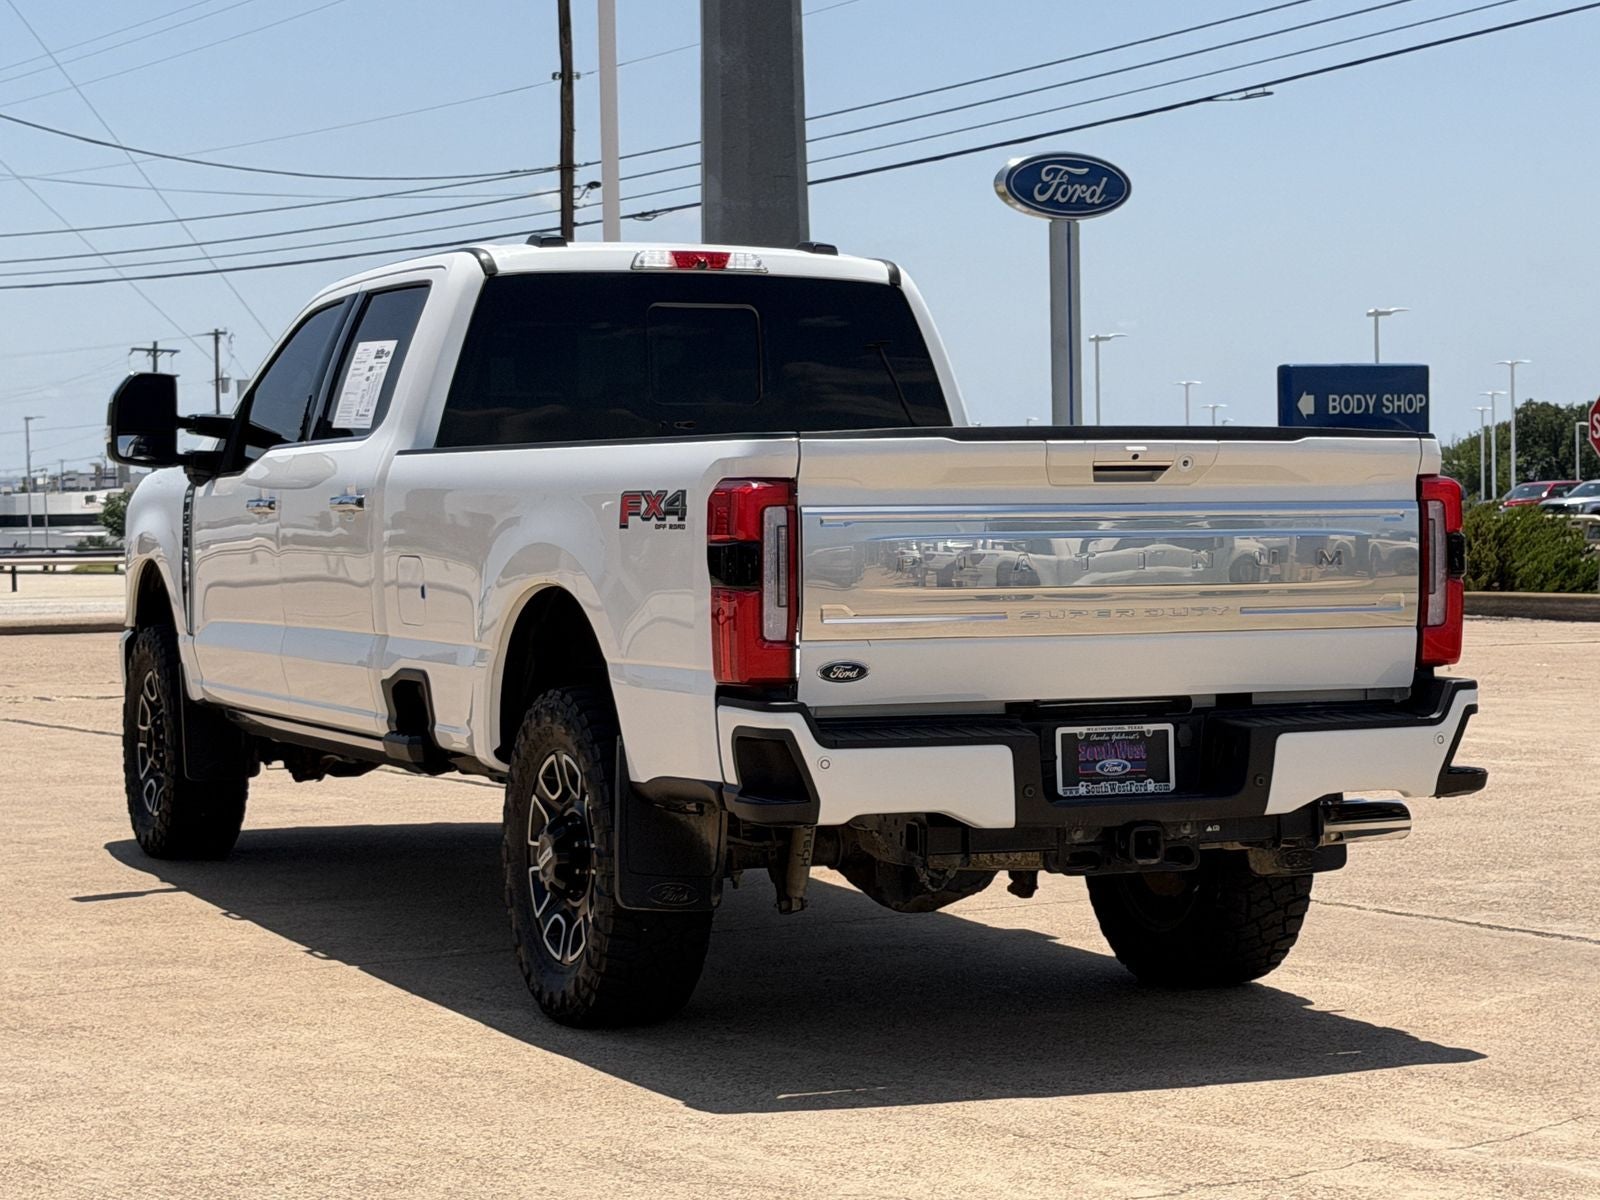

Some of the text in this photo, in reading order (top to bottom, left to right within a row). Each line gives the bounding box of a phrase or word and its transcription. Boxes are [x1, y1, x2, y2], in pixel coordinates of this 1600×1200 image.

[1033, 164, 1107, 204] Ford
[1328, 394, 1426, 414] BODY SHOP
[619, 489, 687, 529] FX4
[1019, 606, 1230, 620] SUPER DUTY
[829, 665, 859, 679] Ford
[1103, 761, 1123, 773] Ford
